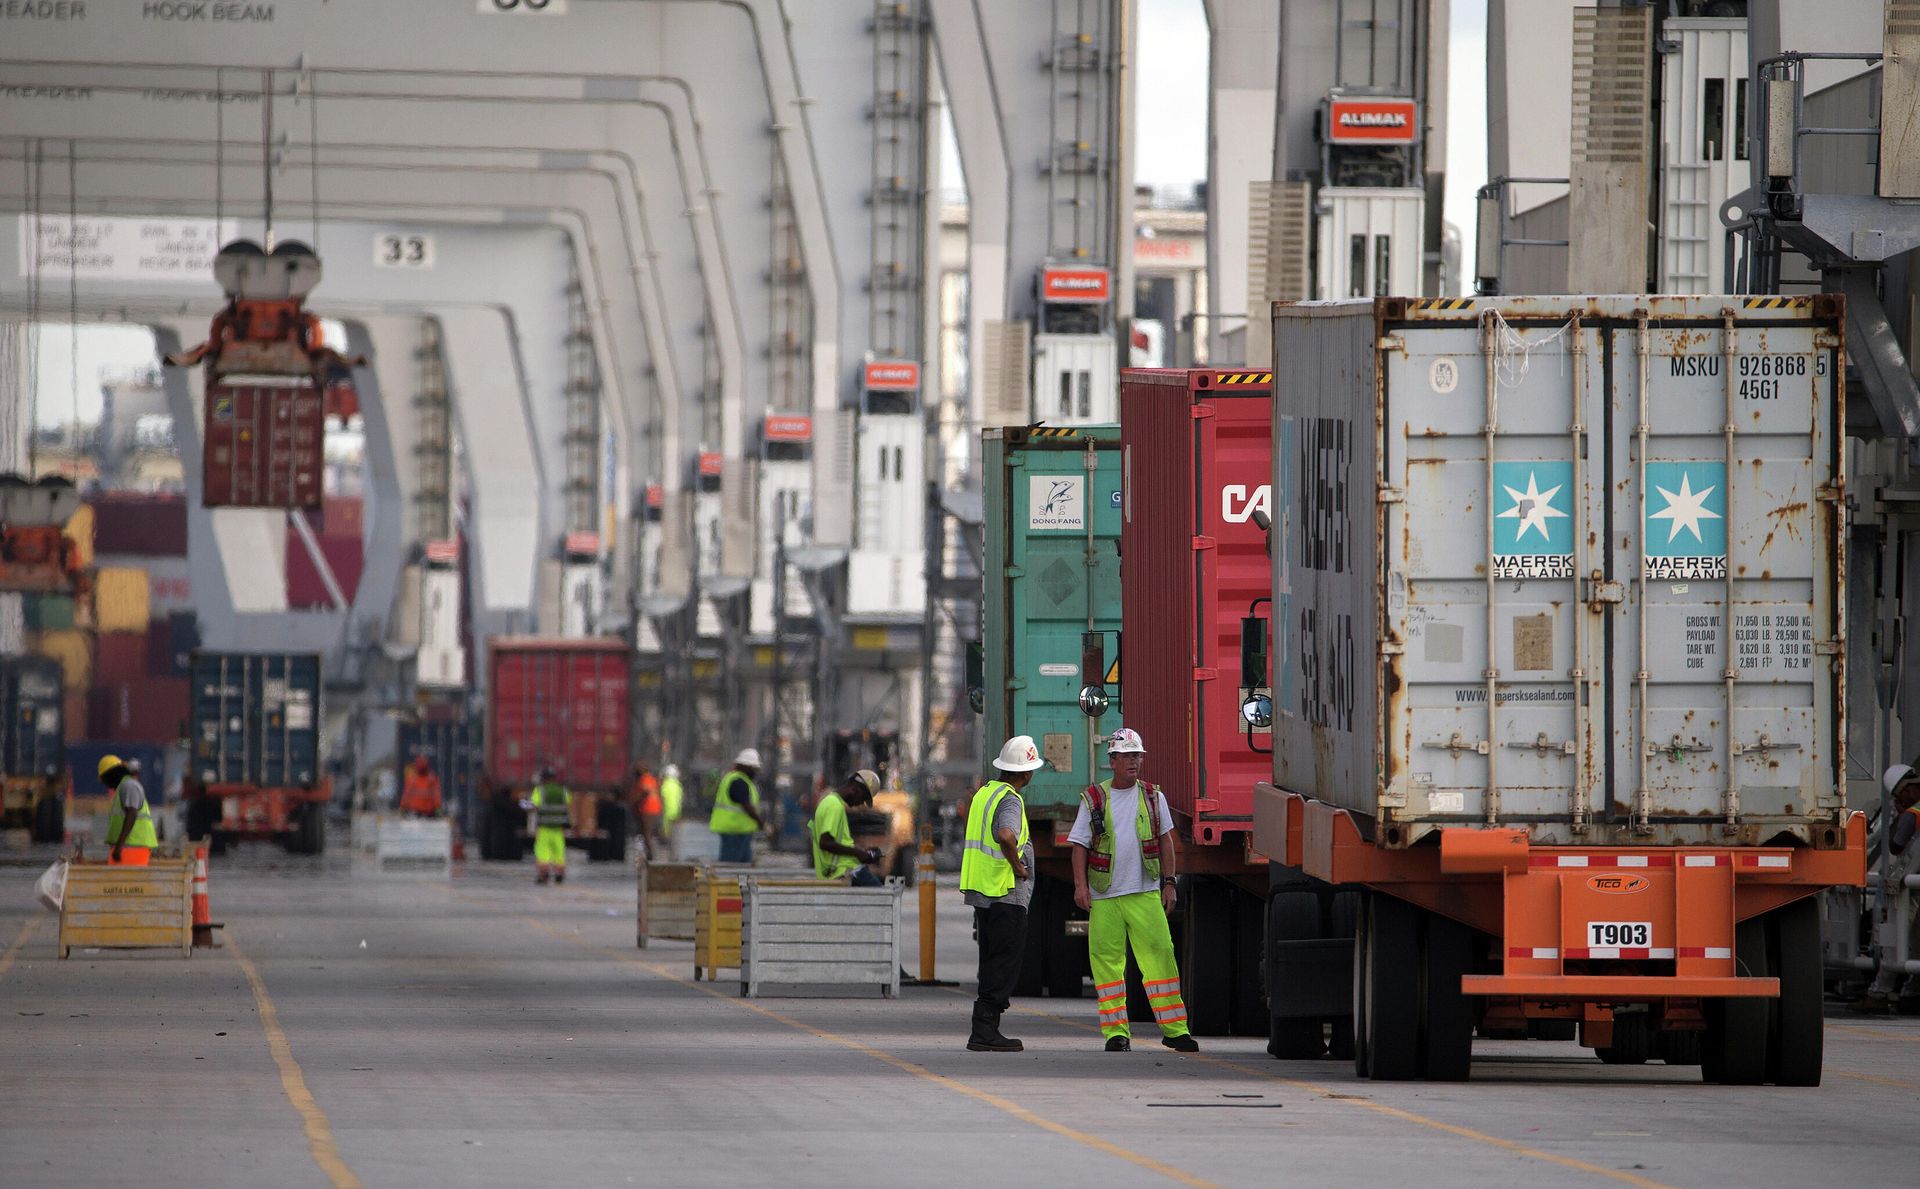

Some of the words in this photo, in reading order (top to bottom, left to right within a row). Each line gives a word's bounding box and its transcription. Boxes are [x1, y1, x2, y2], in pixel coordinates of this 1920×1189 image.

[0, 3, 86, 20] EADER
[142, 2, 204, 21] HOOK
[211, 4, 275, 22] BEAM
[1339, 112, 1407, 126] ALIMAK
[383, 236, 424, 265] 33
[1671, 357, 1719, 376] MSKU
[1816, 355, 1826, 376] 5
[1739, 379, 1779, 400] 45G1
[1493, 555, 1574, 568] MAERSK
[1645, 556, 1726, 569] MAERSK
[1493, 568, 1574, 578] SEALAND
[1645, 569, 1726, 579] SEALAND
[1686, 616, 1709, 627] GROSS
[1709, 616, 1721, 627] WT.
[1735, 616, 1759, 627] 71,650
[1762, 616, 1772, 627] LB.
[1776, 616, 1799, 627] 32,500
[1686, 630, 1716, 641] PAYLOAD
[1735, 630, 1759, 641] 63,030
[1762, 630, 1772, 641] LB.
[1775, 630, 1799, 641] 28,590
[1686, 643, 1703, 655] TARE
[1704, 643, 1716, 655] WT.
[1739, 644, 1759, 655] 8,620
[1762, 644, 1772, 655] LB.
[1779, 644, 1799, 655] 3,910
[1686, 657, 1704, 668] CUBE
[1739, 657, 1758, 669] 2,691
[1783, 657, 1799, 669] 76.2
[1591, 924, 1648, 945] T903
